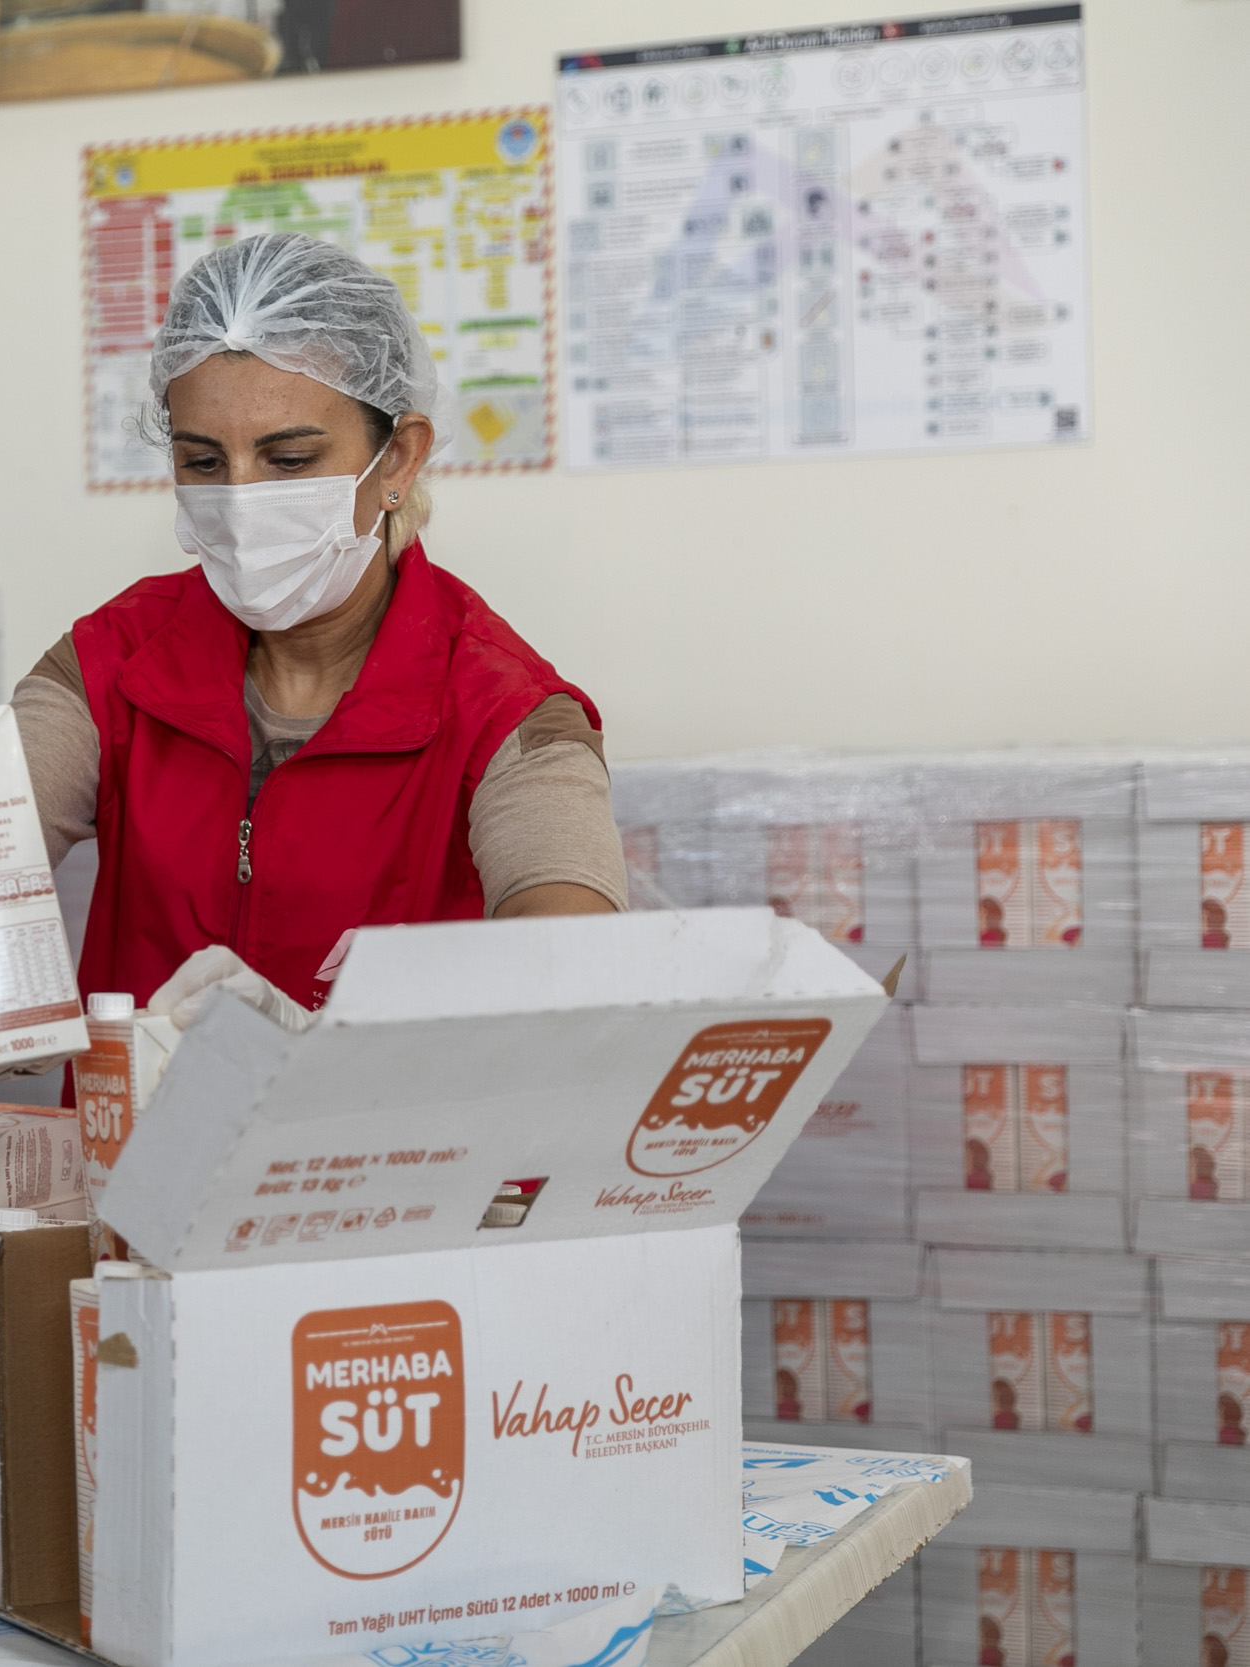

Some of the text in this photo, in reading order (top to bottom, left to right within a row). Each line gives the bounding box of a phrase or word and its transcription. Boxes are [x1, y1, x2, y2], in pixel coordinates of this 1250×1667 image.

[10, 1037, 34, 1050] 1000
[683, 1047, 805, 1069] MERHABA
[80, 1072, 126, 1094] MERHABA
[671, 1067, 781, 1107] SÜT
[85, 1095, 123, 1142] SÜT
[306, 1157, 326, 1172] 12
[327, 1155, 367, 1170] Adet
[385, 1150, 427, 1165] 1000
[301, 1178, 319, 1192] 13
[321, 1176, 344, 1193] Kg
[594, 1183, 657, 1215] Vahap
[306, 1349, 452, 1390] MERHABA
[320, 1387, 441, 1457] SÜT
[492, 1373, 693, 1458] Vahap Seçer
[606, 1428, 645, 1443] MERSİN
[648, 1419, 711, 1437] BÜYÜKŞEHİR
[585, 1438, 677, 1459] BELEDİYE BAŞKANI
[320, 1506, 436, 1530] MERSİN HAMİLE BAKIM
[363, 1525, 392, 1542] SÜTÜ
[328, 1620, 358, 1636] Tam
[361, 1614, 394, 1634] Yağlı
[399, 1608, 425, 1627] UHT
[466, 1599, 498, 1617] Sütü
[501, 1597, 516, 1612] 12
[519, 1592, 551, 1610] Adet
[566, 1585, 599, 1604] 1000
[602, 1582, 620, 1599] ml
